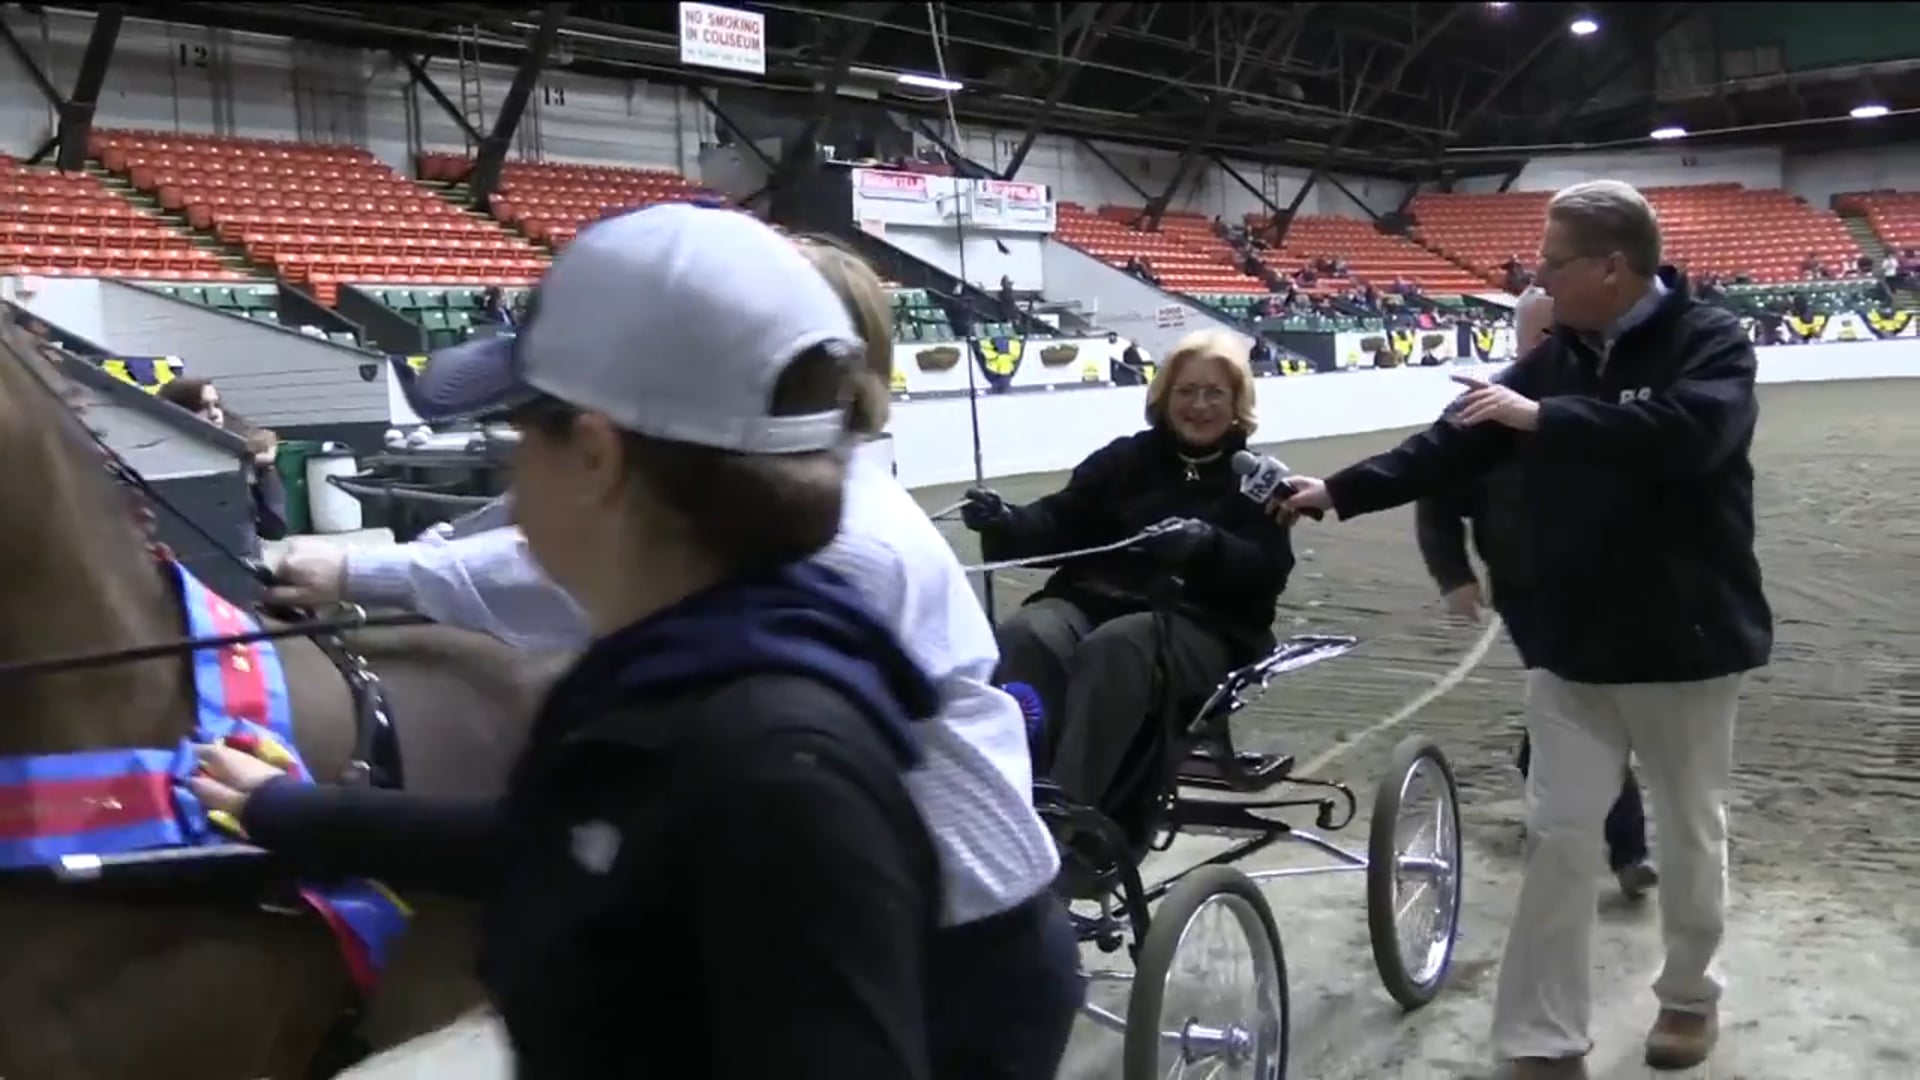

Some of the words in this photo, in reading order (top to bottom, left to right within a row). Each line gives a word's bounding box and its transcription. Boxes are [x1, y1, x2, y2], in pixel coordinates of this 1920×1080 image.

[685, 10, 702, 24] NO
[708, 12, 760, 35] SMOKING
[685, 26, 697, 40] IN
[703, 28, 760, 50] COLISEUM
[179, 43, 208, 68] 12
[544, 86, 565, 106] 13
